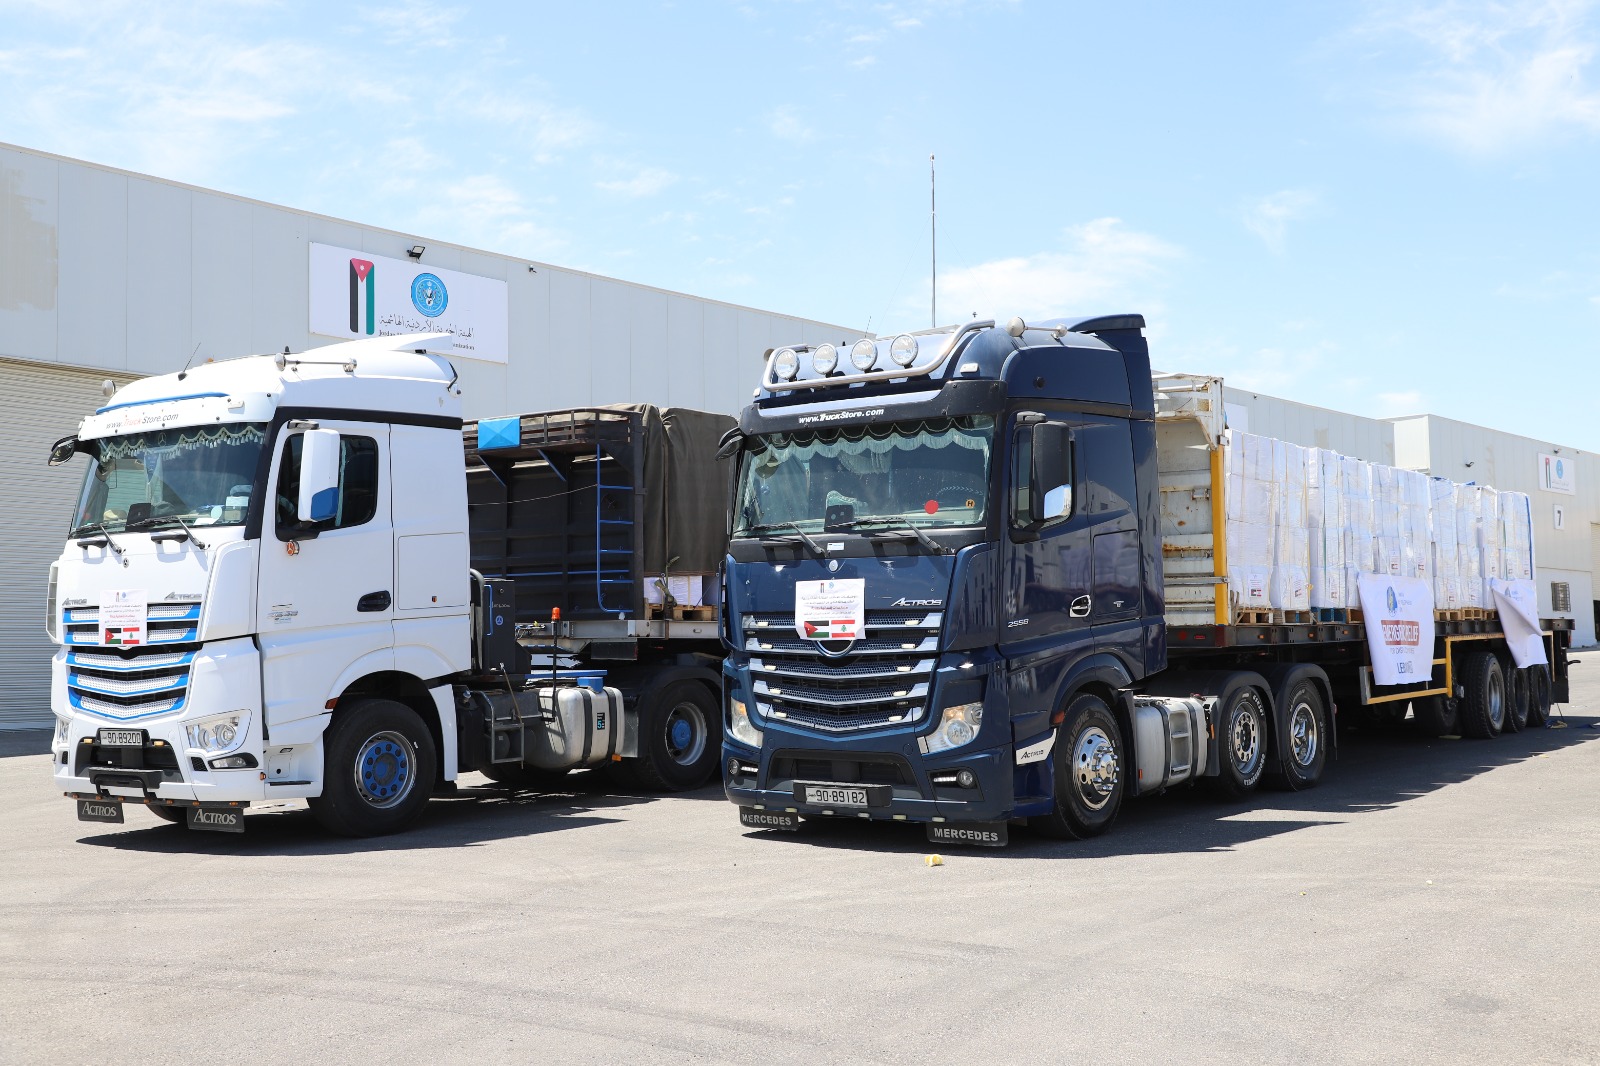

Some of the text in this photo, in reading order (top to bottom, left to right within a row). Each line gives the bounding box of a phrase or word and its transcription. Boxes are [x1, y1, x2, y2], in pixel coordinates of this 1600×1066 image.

[105, 413, 179, 429] www.TruckStore.com
[799, 408, 885, 424] www.TruckStore.com
[741, 813, 792, 826] MERCEDES
[933, 827, 999, 842] MERCEDES
